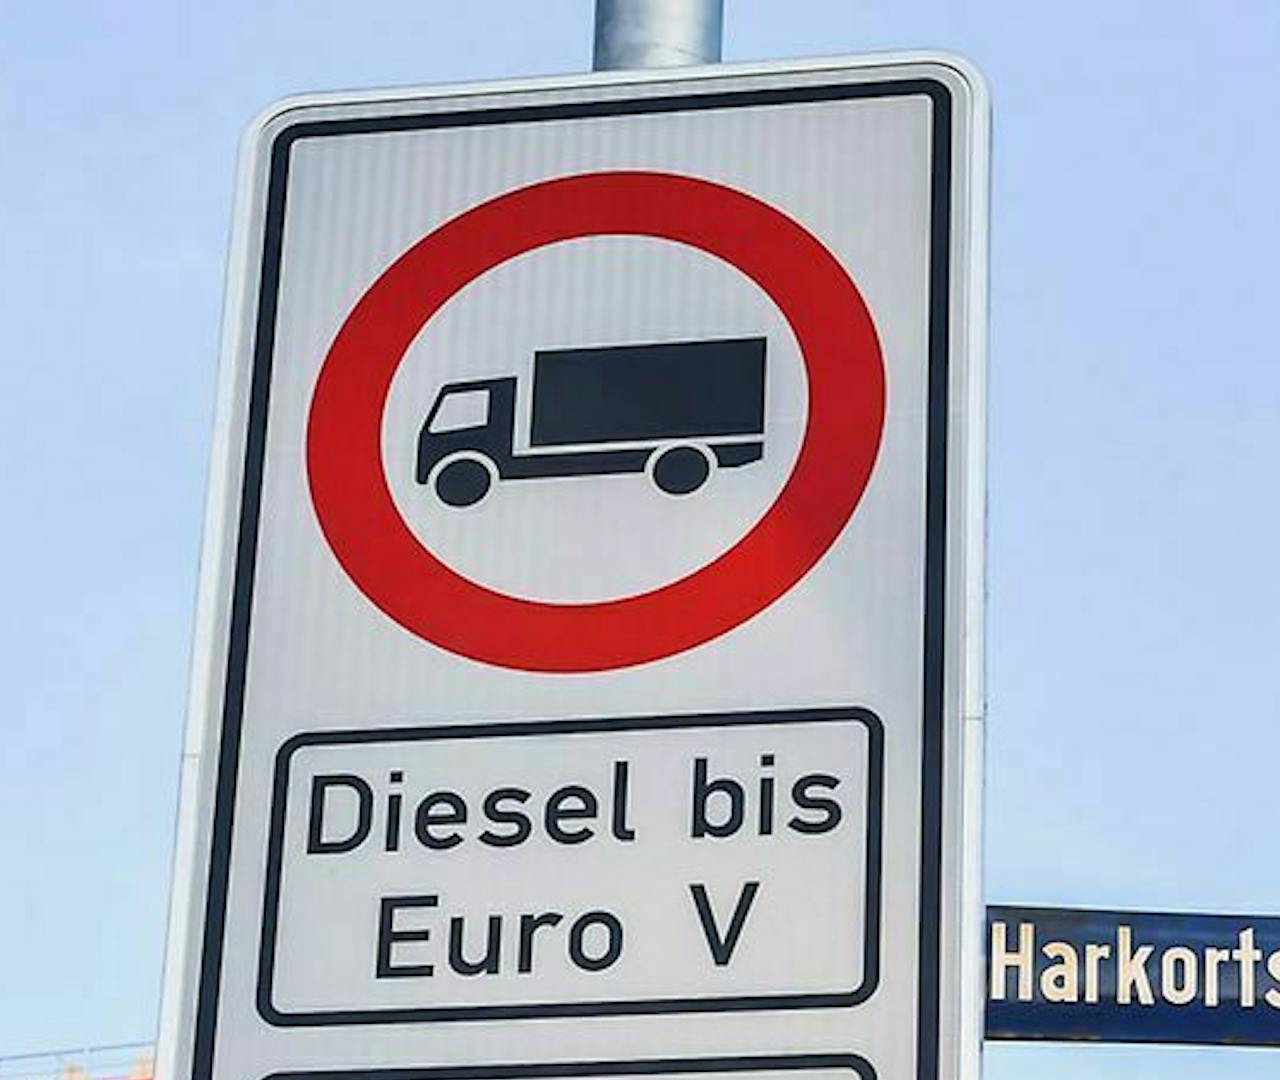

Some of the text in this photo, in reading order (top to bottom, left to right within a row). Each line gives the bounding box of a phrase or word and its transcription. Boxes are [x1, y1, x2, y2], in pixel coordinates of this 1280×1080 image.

[306, 753, 842, 855] Diesel bis
[375, 881, 760, 980] Euro V
